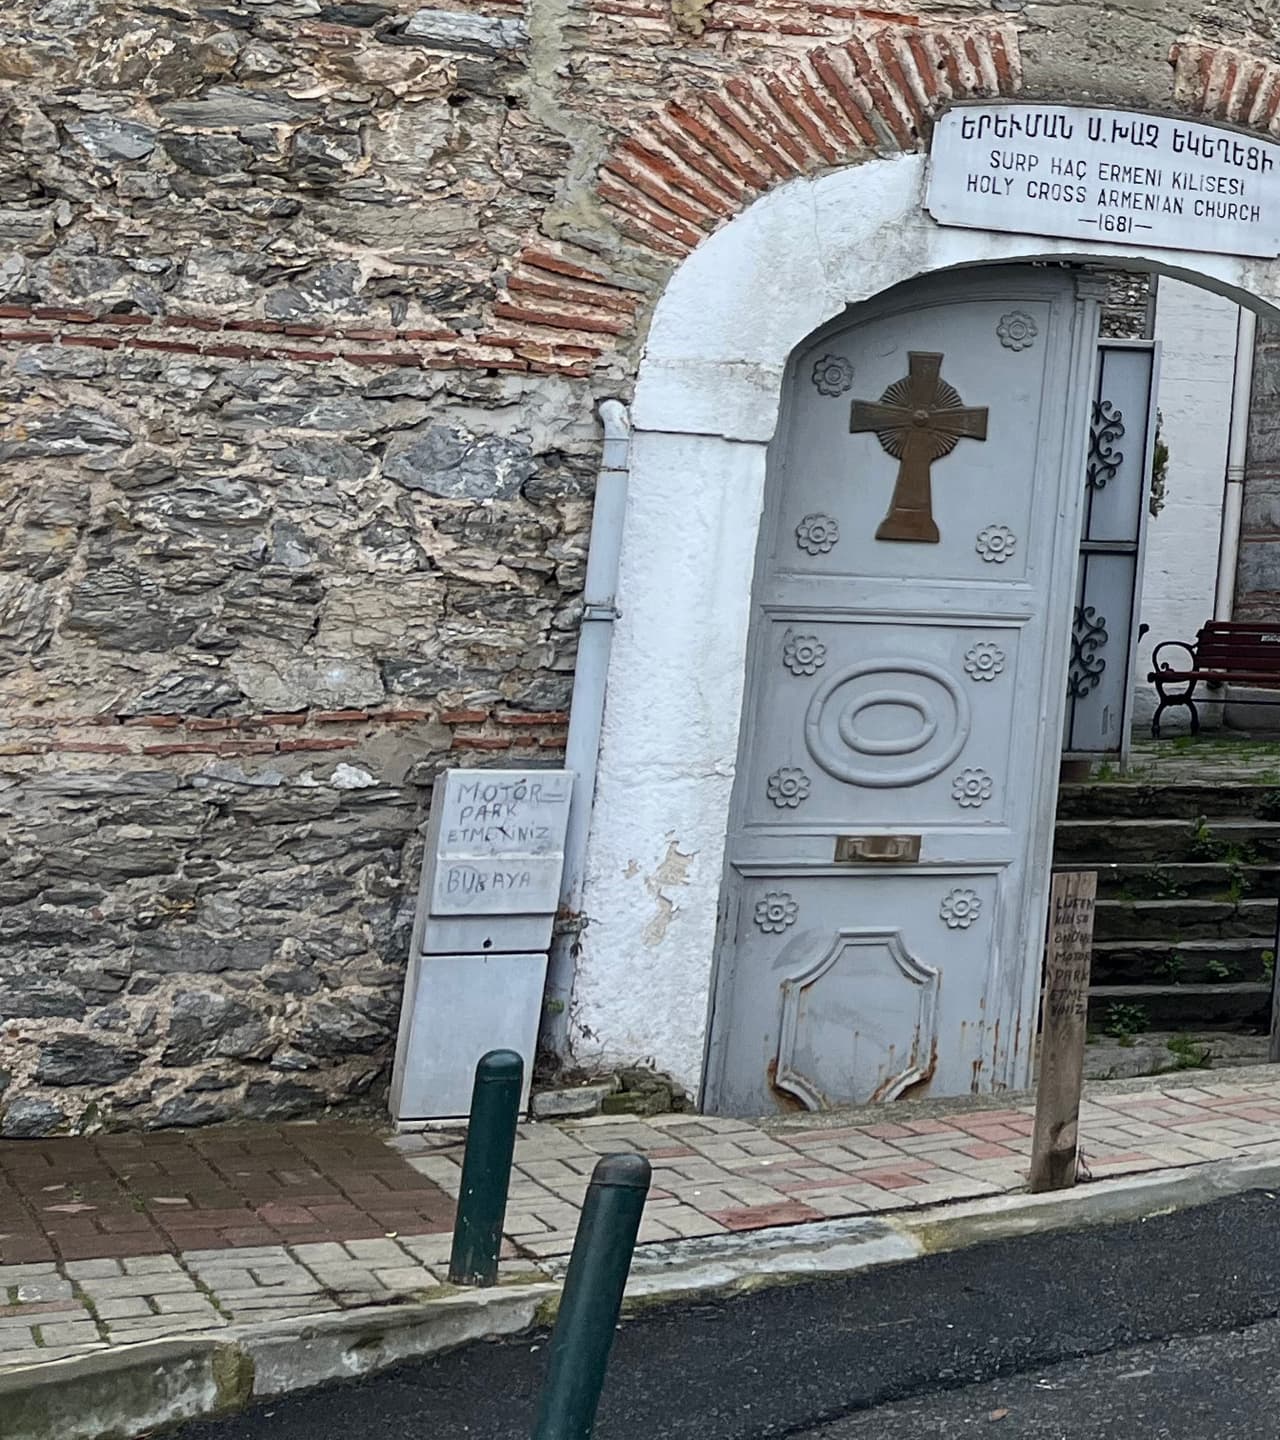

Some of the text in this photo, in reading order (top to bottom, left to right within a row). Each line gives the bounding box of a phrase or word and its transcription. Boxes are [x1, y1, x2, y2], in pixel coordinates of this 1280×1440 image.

[990, 150, 1039, 172] SURP
[1051, 157, 1087, 181] HAÇ
[967, 174, 1261, 222] HOLY CROSS ARMENIAN CHURCH
[459, 803, 517, 825] PARK
[447, 869, 530, 894] BURAYA
